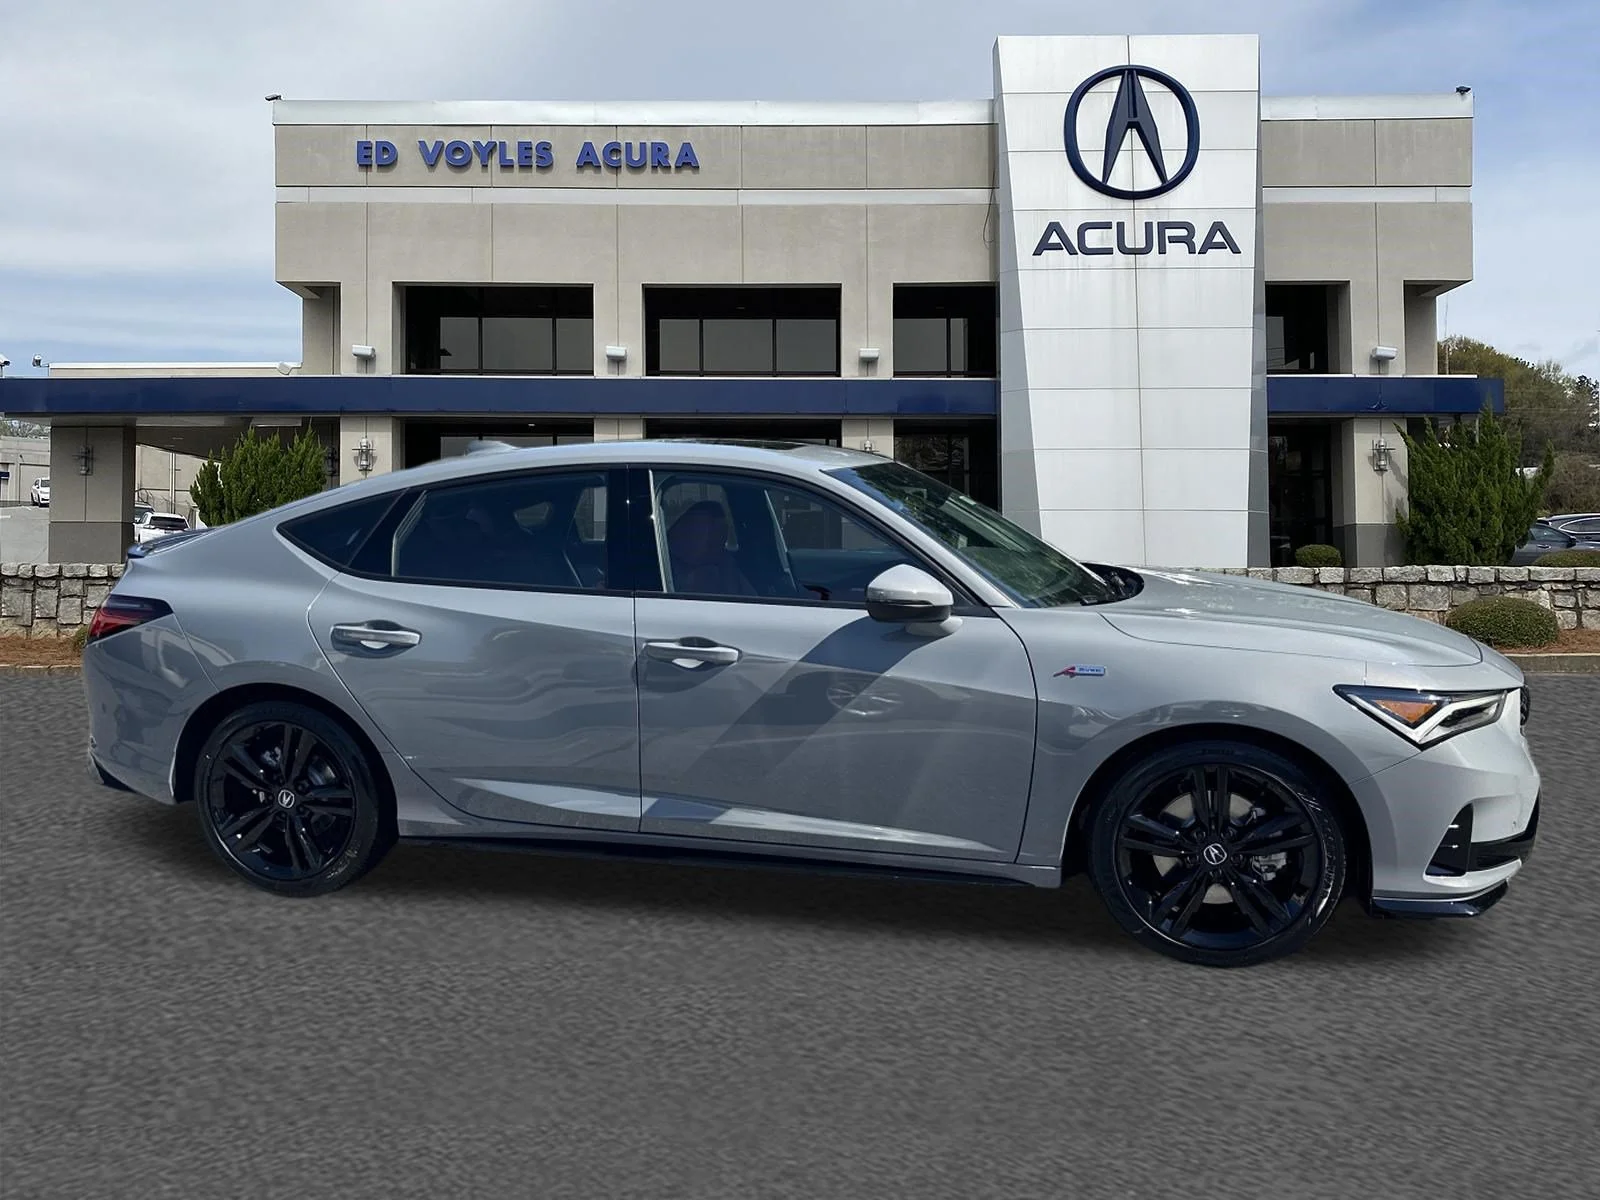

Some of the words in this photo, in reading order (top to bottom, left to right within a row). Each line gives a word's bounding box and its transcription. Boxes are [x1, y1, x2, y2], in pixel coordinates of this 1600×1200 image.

[356, 140, 398, 168] ED
[418, 140, 555, 169] VOYLES
[576, 140, 700, 170] ACURA
[1032, 220, 1242, 256] ACURA
